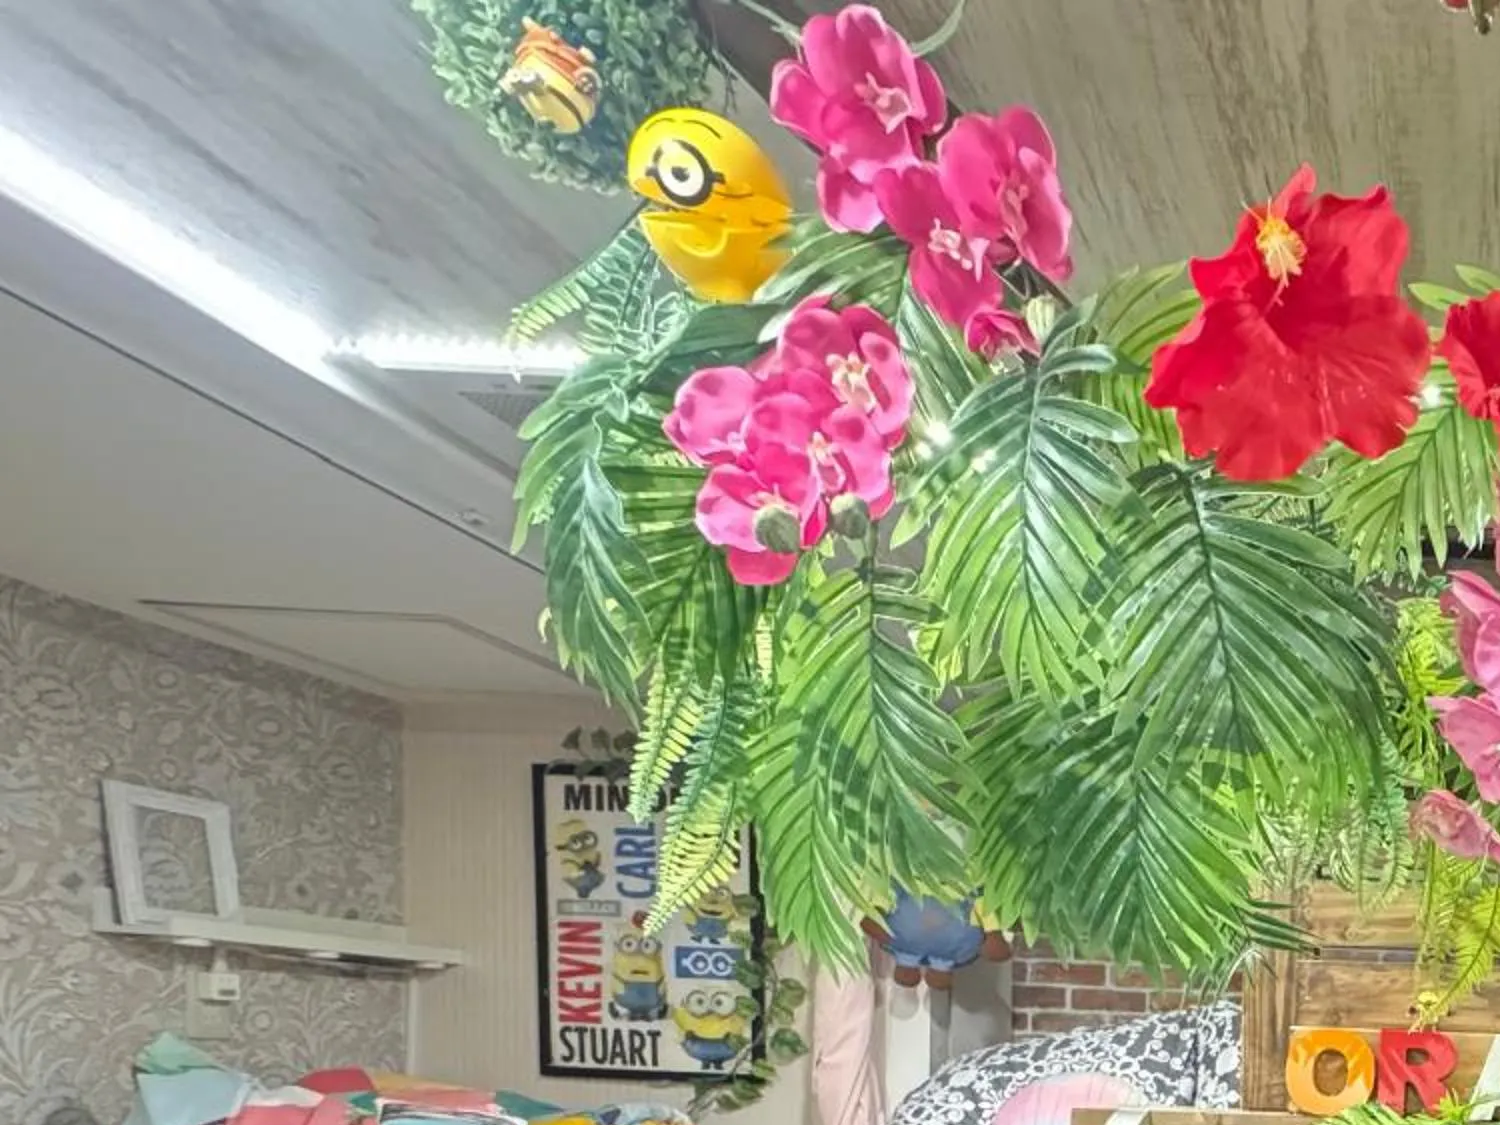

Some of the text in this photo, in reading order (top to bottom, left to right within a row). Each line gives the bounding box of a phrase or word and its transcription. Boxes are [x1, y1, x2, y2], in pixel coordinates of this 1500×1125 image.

[614, 822, 657, 898] CARL
[557, 921, 602, 1024] KEVIN
[559, 1025, 662, 1067] STUART
